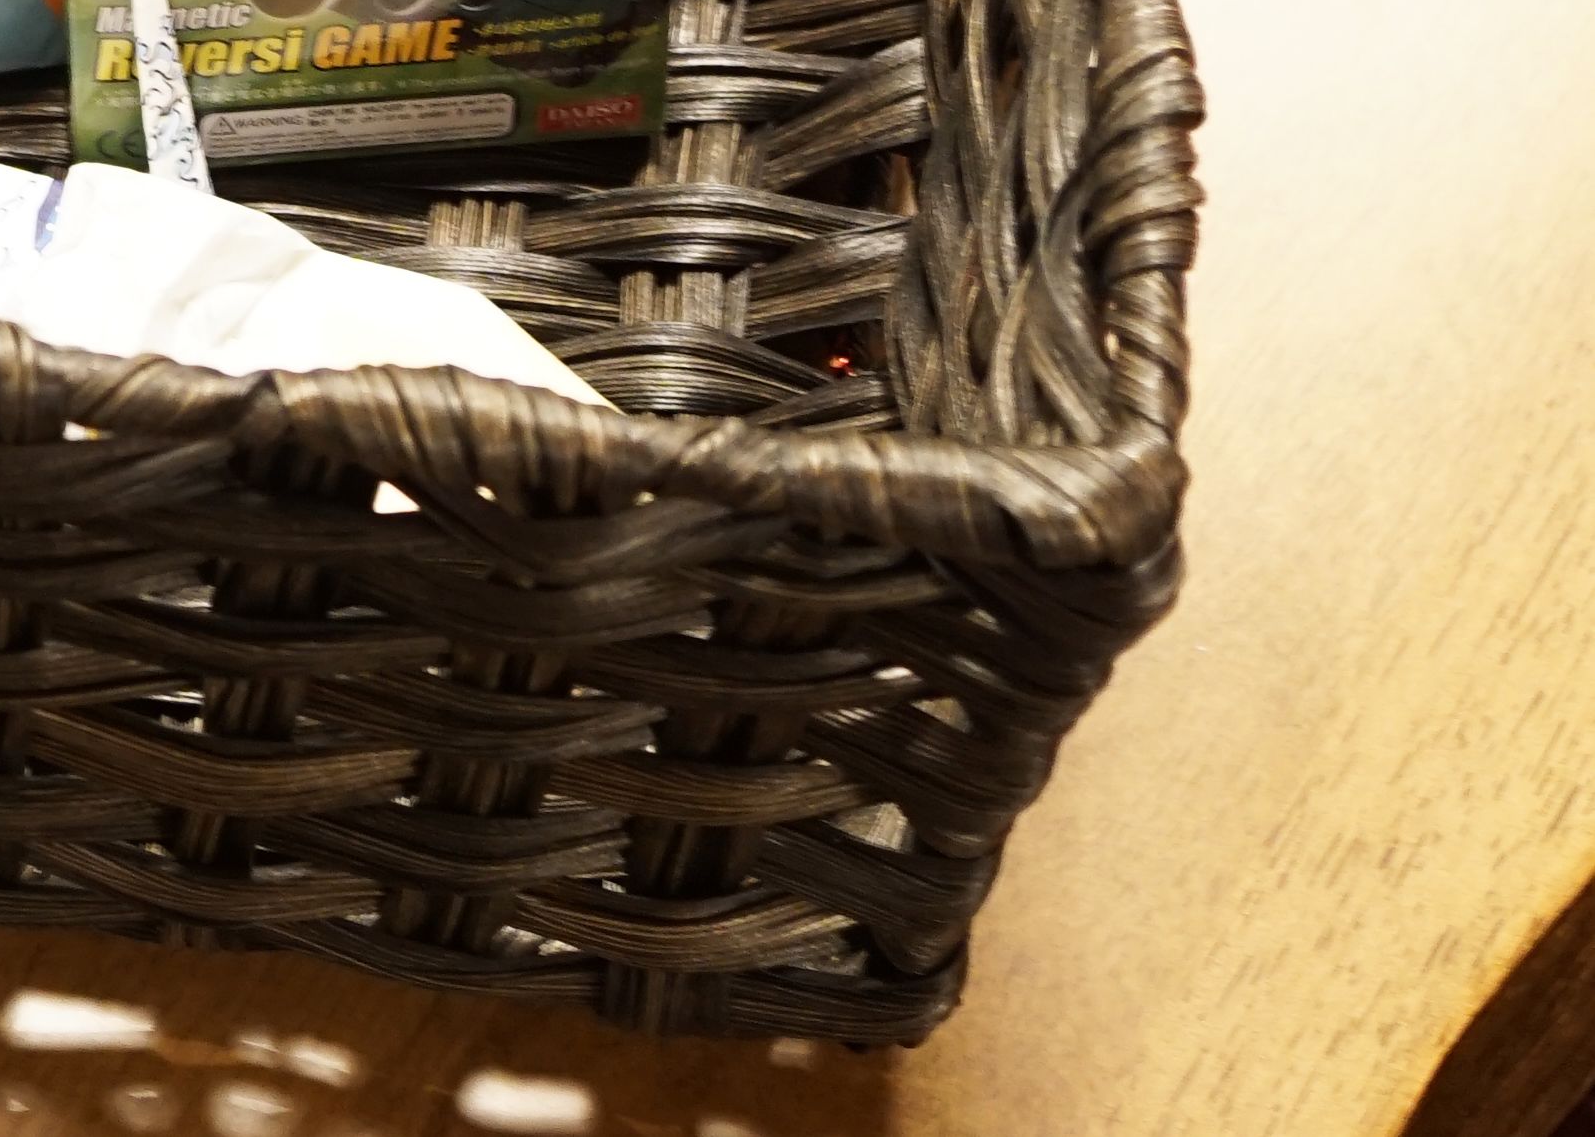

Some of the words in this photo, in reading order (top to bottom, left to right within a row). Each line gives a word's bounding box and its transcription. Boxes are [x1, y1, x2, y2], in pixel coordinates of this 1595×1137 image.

[95, 1, 252, 33] Mnetic
[94, 27, 306, 82] Rversi
[312, 18, 466, 70] GAME
